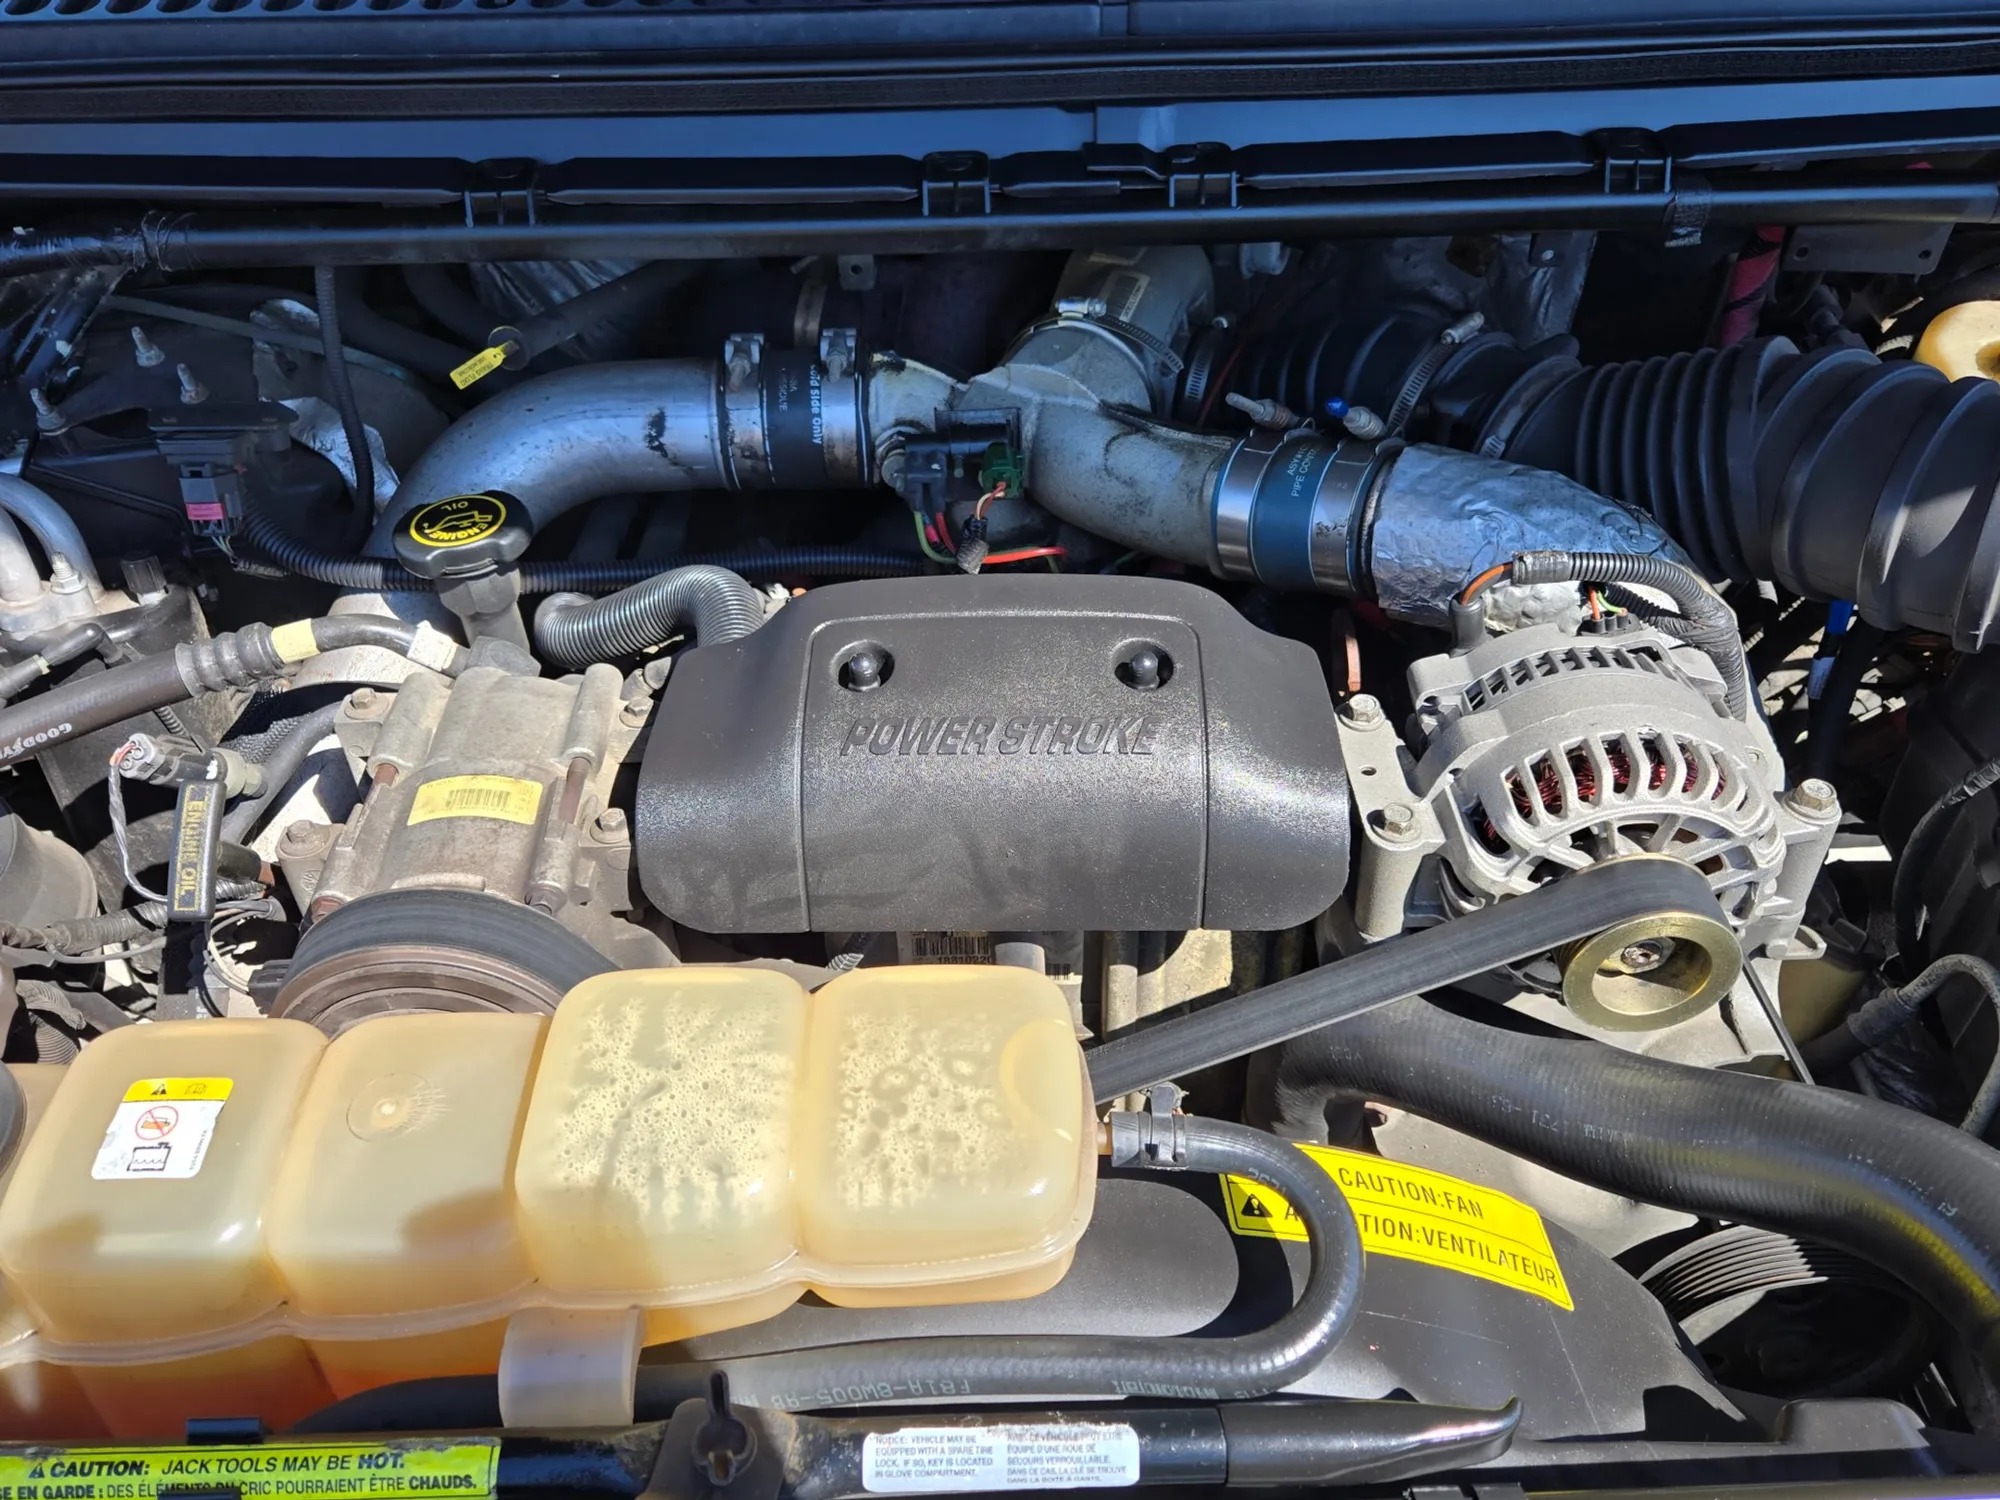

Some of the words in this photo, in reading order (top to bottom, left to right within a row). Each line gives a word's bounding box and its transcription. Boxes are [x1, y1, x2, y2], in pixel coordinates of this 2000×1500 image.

[1291, 474, 1305, 497] PIPE
[441, 501, 469, 511] OIL
[428, 522, 489, 541] ENGINE
[0, 722, 72, 759] GOODY
[840, 715, 997, 756] POWER
[998, 714, 1162, 755] STROKE
[181, 800, 207, 863] ENGINE
[179, 867, 197, 896] OIL
[911, 1435, 943, 1444] VEHICLE
[946, 1435, 964, 1443] MAY
[965, 1435, 977, 1443] BE
[875, 1447, 916, 1456] EQUIPPED
[918, 1446, 938, 1456] WITH
[939, 1446, 945, 1455] A
[948, 1446, 973, 1455] SPARE
[975, 1446, 993, 1455] TIRE
[50, 1459, 150, 1478] CAUTION:
[161, 1458, 212, 1475] JACK
[215, 1457, 278, 1474] TOOLS
[282, 1455, 324, 1472] MAY
[326, 1454, 352, 1470] BE
[358, 1452, 405, 1469] HOT.
[903, 1459, 911, 1467] IF
[928, 1458, 943, 1467] KEY
[945, 1458, 954, 1466] IS
[955, 1457, 993, 1466] LOCATED
[1007, 1467, 1027, 1476] DANS
[1059, 1467, 1069, 1475] LA
[1086, 1466, 1096, 1474] SE
[875, 1470, 883, 1478] IN
[885, 1469, 912, 1478] GLOVE
[17, 1485, 37, 1499] EN
[107, 1483, 133, 1498] DES
[239, 1480, 271, 1495] CRIC
[276, 1477, 365, 1495] POURRAIENT
[369, 1472, 404, 1492] ÊTRE
[409, 1474, 477, 1491] CHAUDS.
